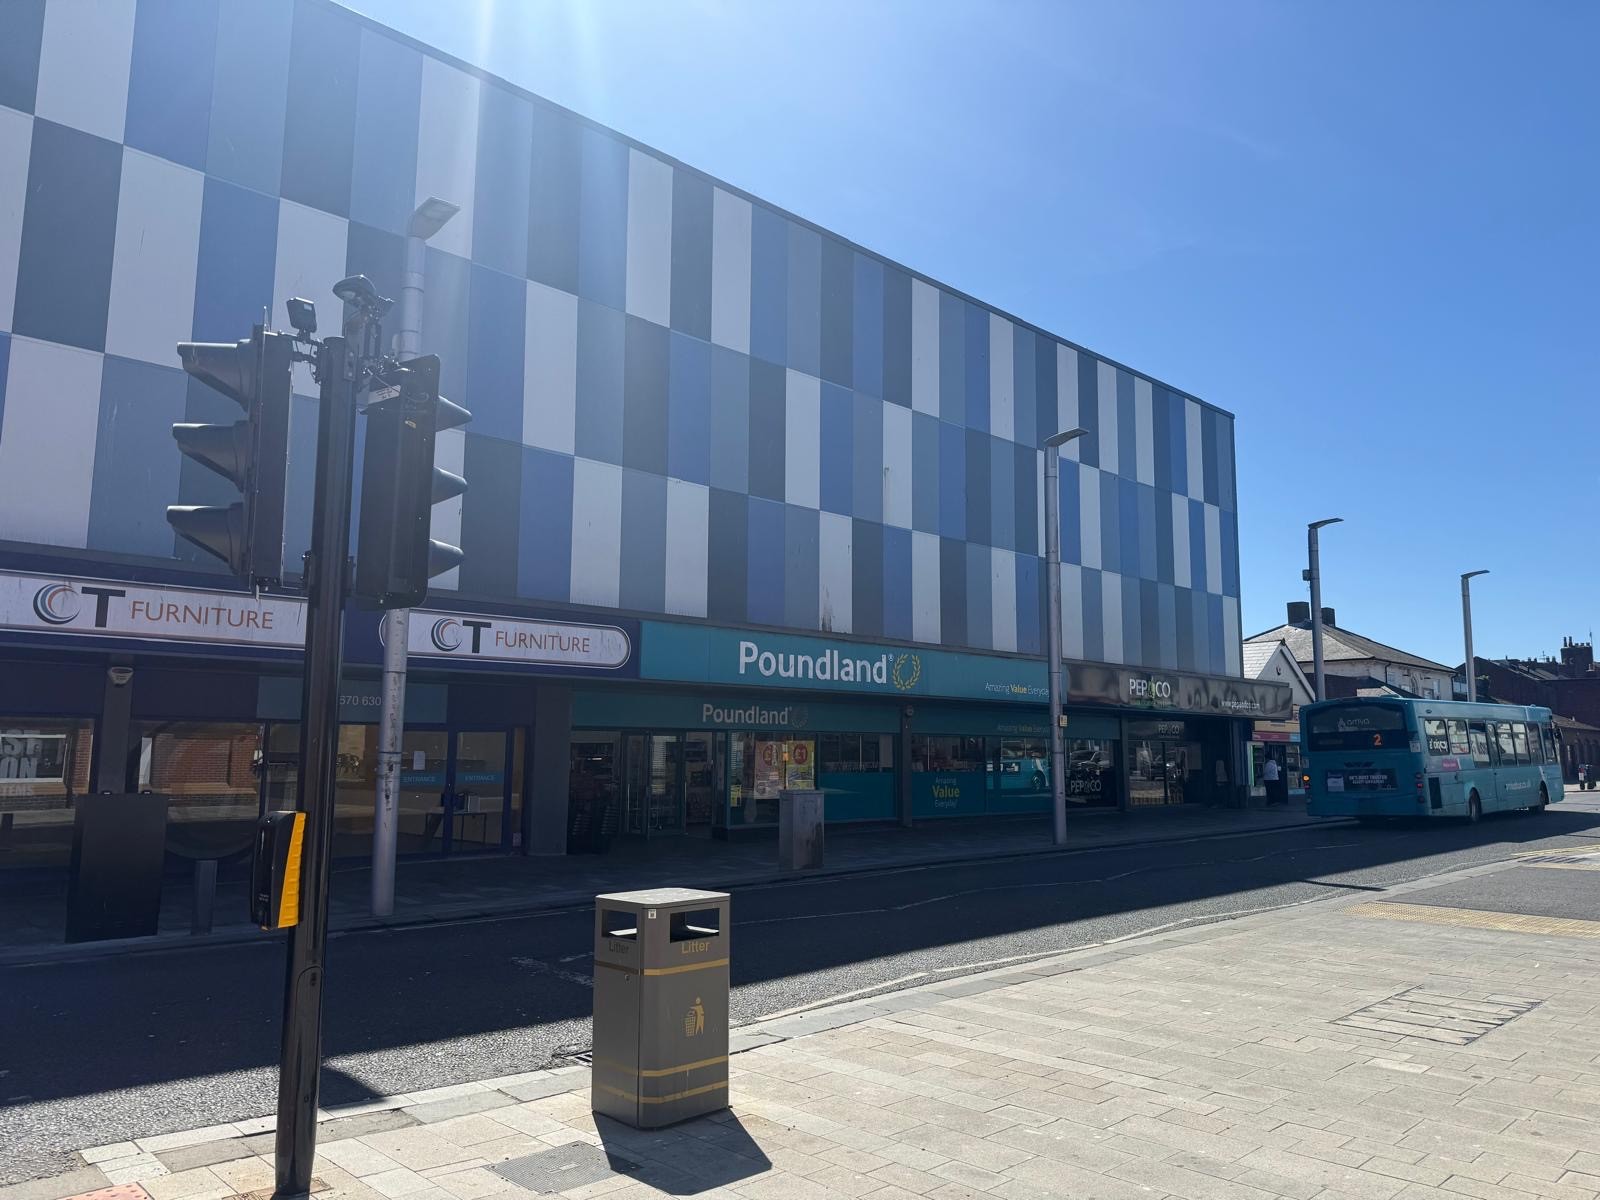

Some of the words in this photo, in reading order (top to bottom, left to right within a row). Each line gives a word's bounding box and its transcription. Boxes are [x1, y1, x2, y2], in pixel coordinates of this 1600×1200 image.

[33, 583, 126, 628] CT
[130, 600, 275, 630] FURNITURE
[431, 617, 492, 654] CT
[495, 630, 591, 653] FURNITURE
[738, 640, 888, 684] Poundland
[985, 681, 1009, 695] Amazing
[1010, 683, 1027, 695] Value
[702, 703, 789, 726] Poundland
[1373, 733, 1382, 746] 2
[403, 775, 436, 784] ENTRANCE
[464, 773, 496, 782] ENTRANCE
[931, 784, 960, 799] Value
[609, 939, 630, 954] Litter
[681, 941, 711, 954] Litter
